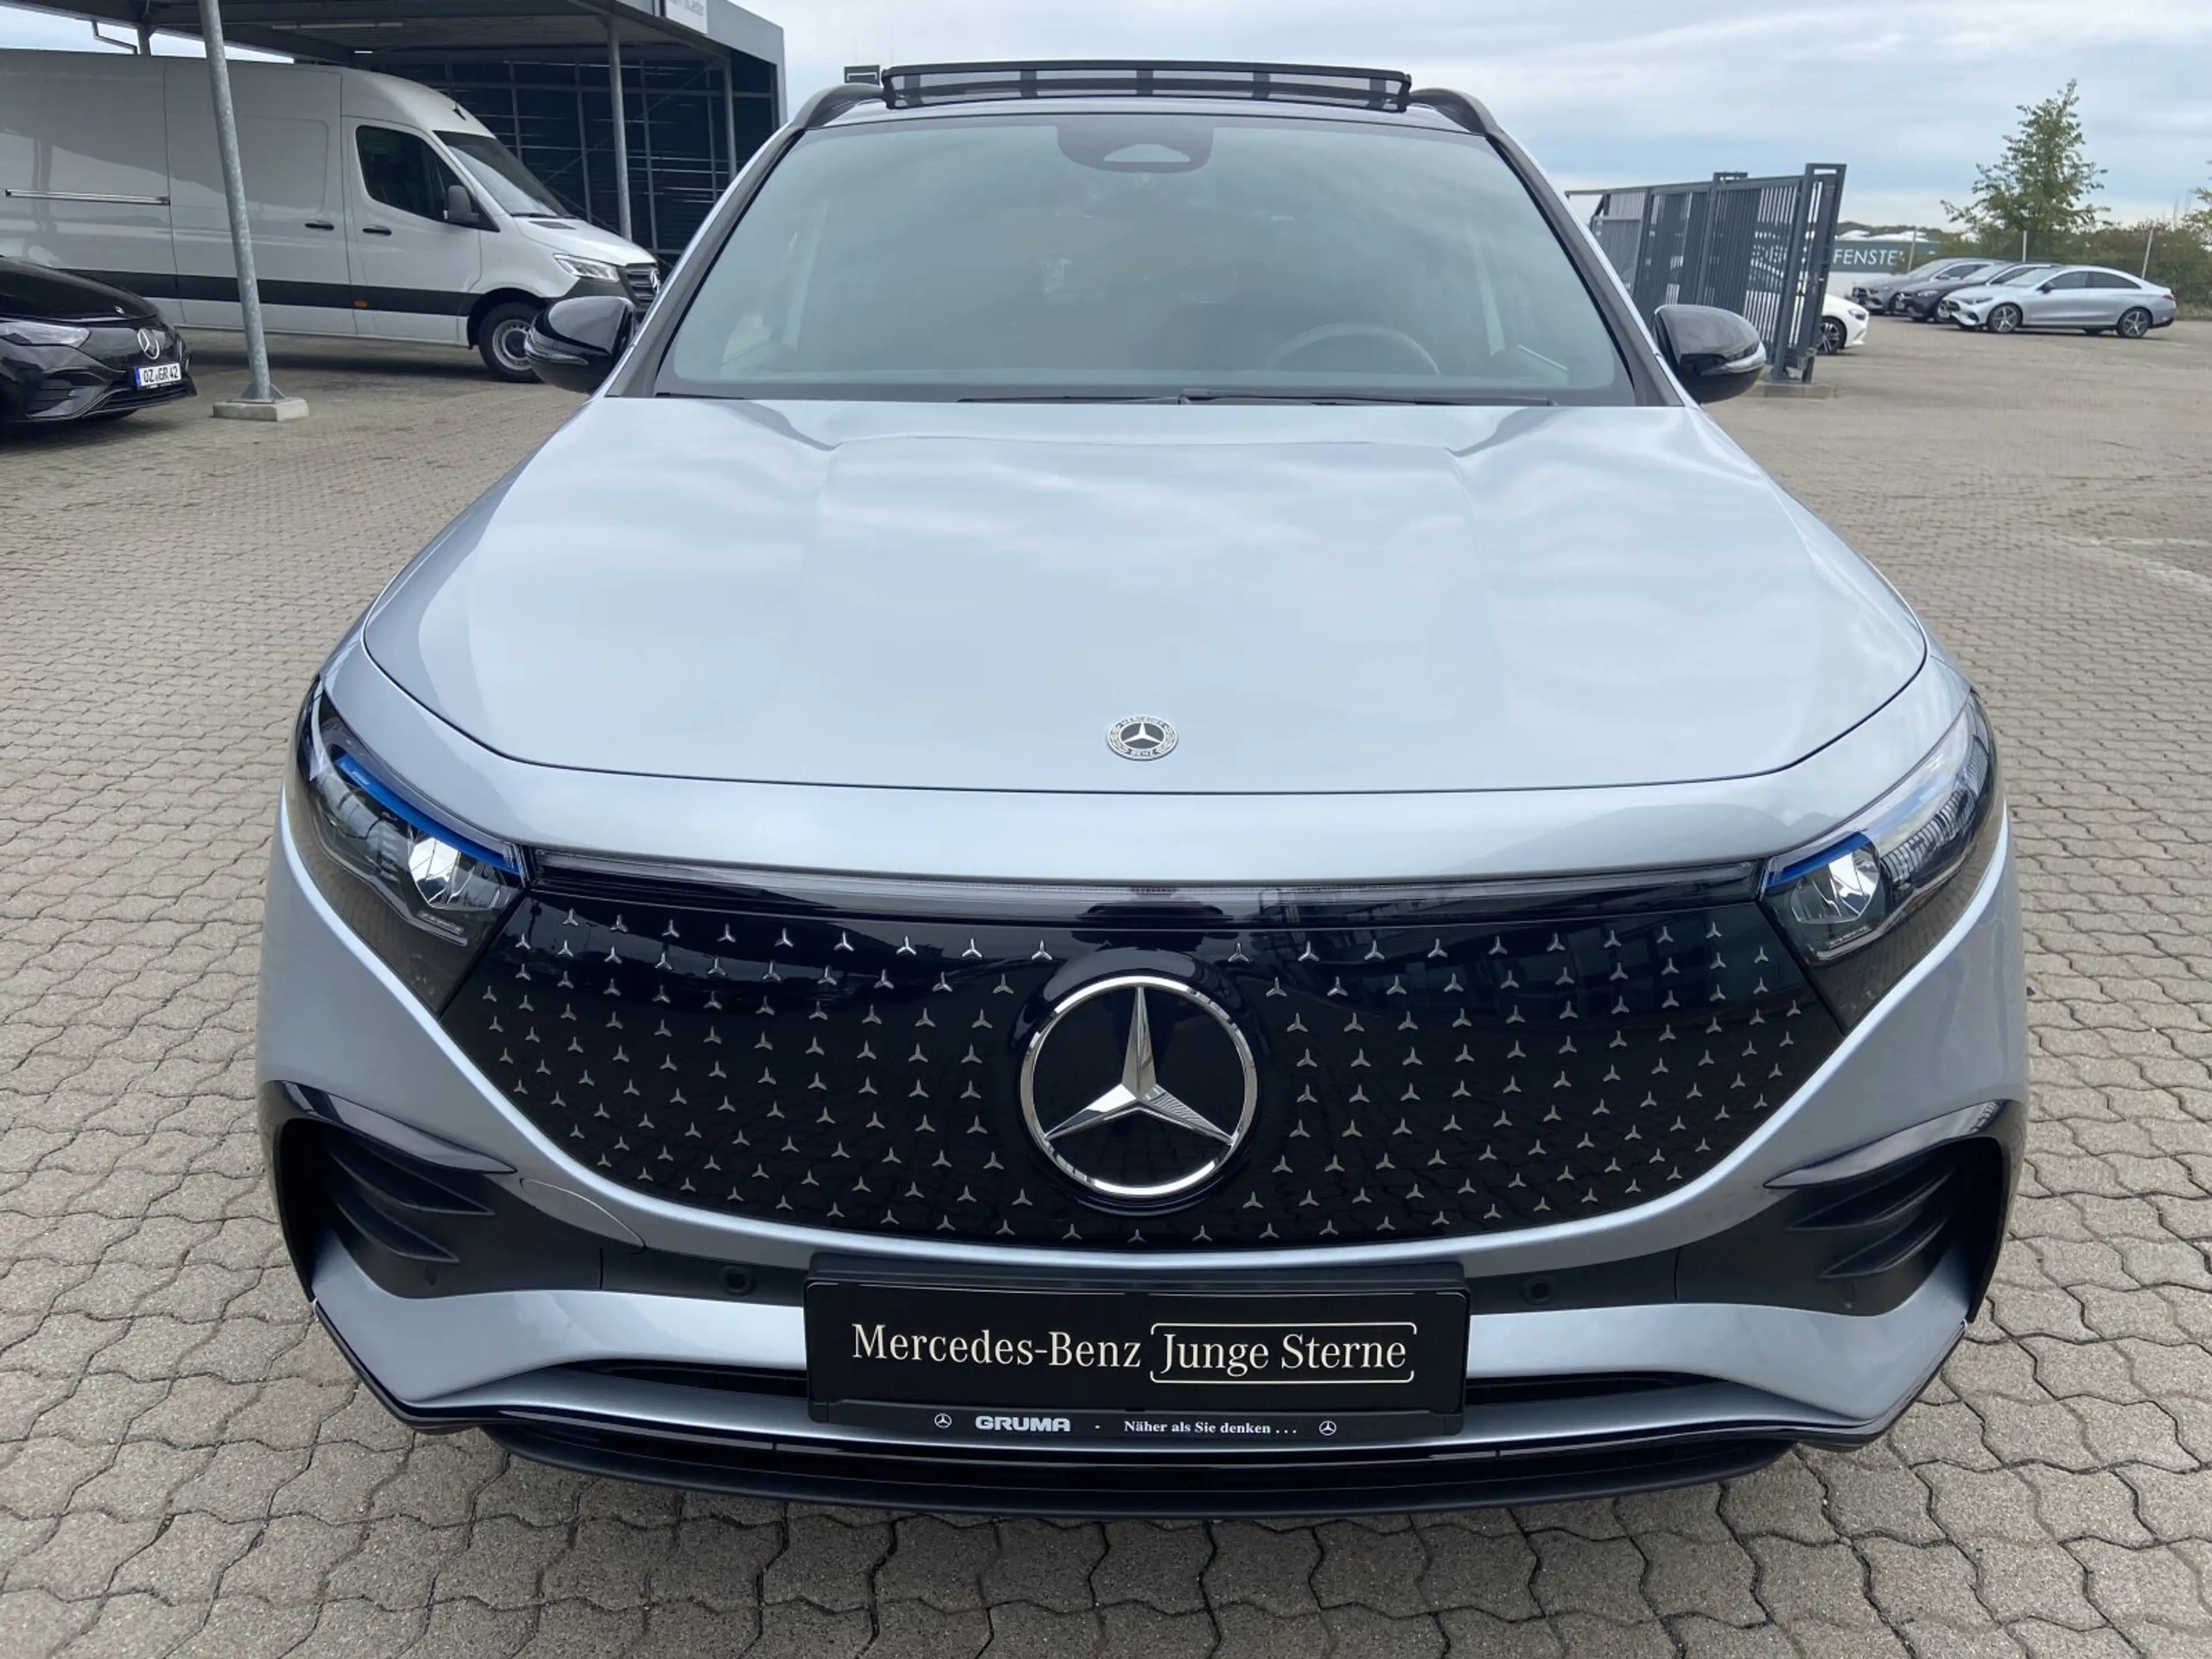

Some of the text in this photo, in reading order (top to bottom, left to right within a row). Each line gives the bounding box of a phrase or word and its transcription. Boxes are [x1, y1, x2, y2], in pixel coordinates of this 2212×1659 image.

[170, 365, 179, 378] 42
[852, 1323, 1406, 1377] Mercedes-Benz Junge Sterne
[975, 1415, 1071, 1432] GRUMA
[1123, 1420, 1168, 1433] Näher
[1171, 1421, 1191, 1433] als
[1194, 1421, 1217, 1433] Sie
